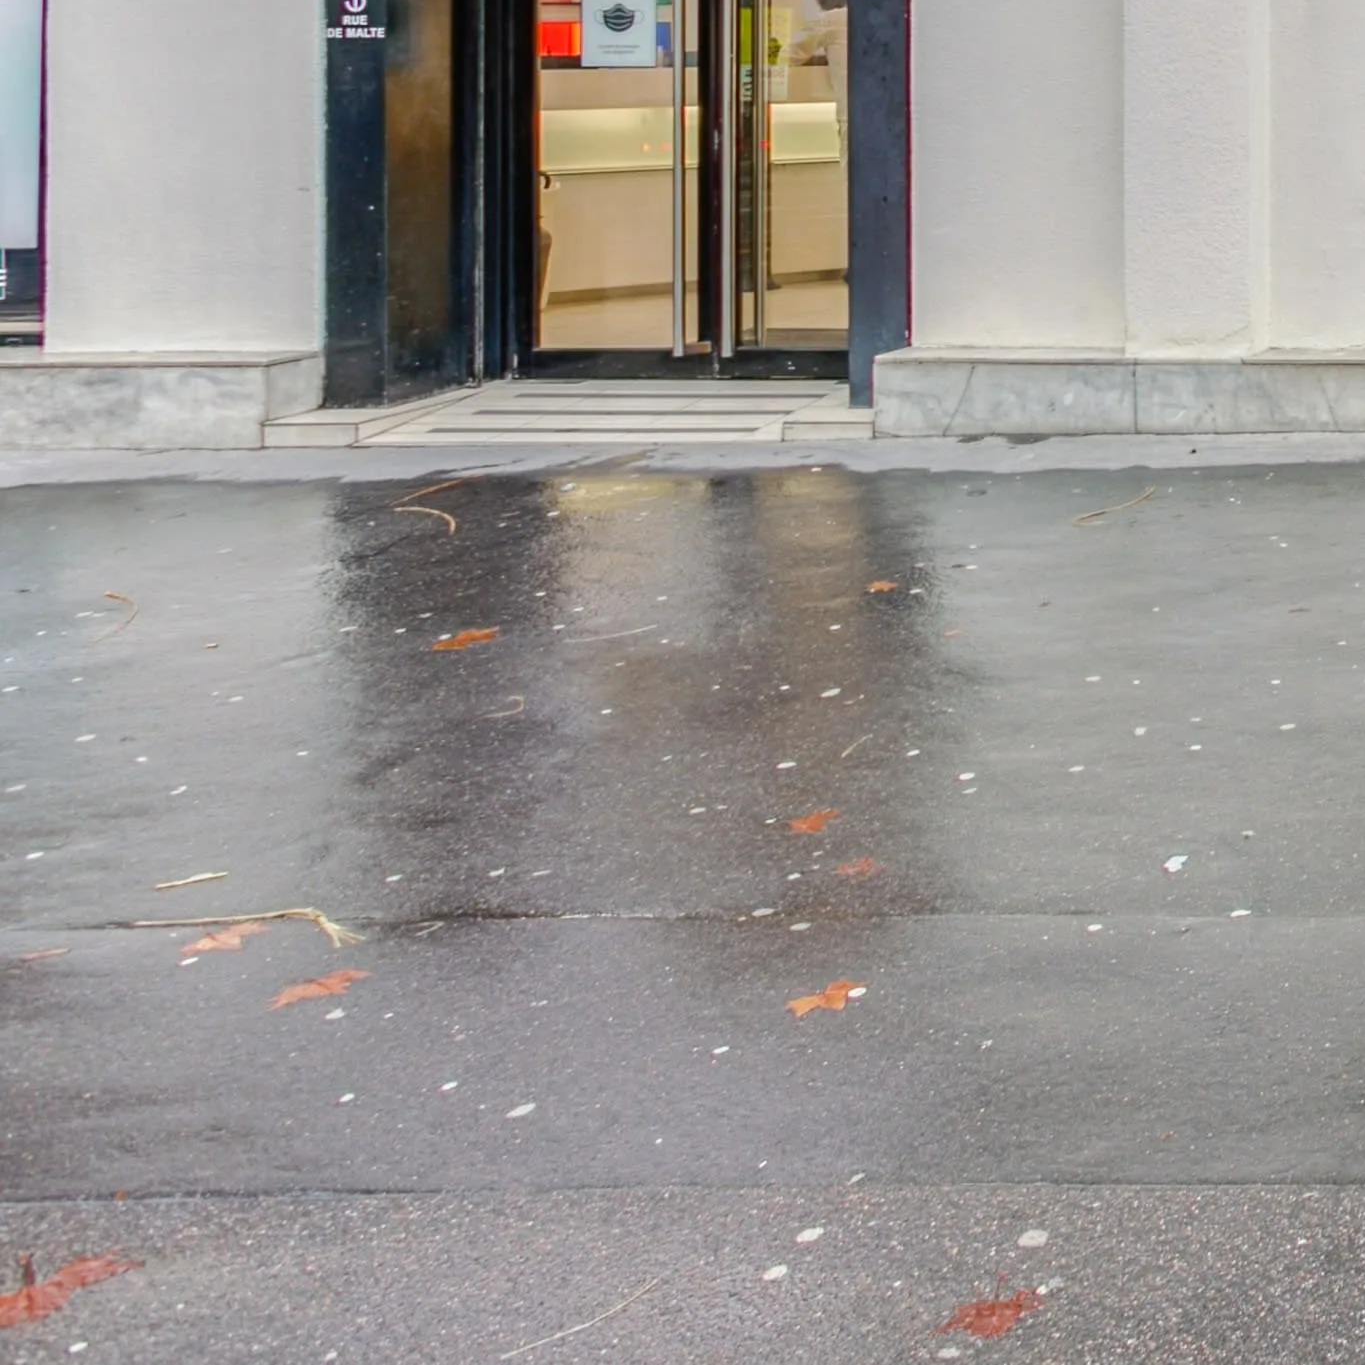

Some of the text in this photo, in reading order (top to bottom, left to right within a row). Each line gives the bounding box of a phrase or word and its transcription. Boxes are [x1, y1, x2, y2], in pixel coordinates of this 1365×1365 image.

[342, 15, 368, 26] RUE
[327, 27, 385, 38] DE MALTE
